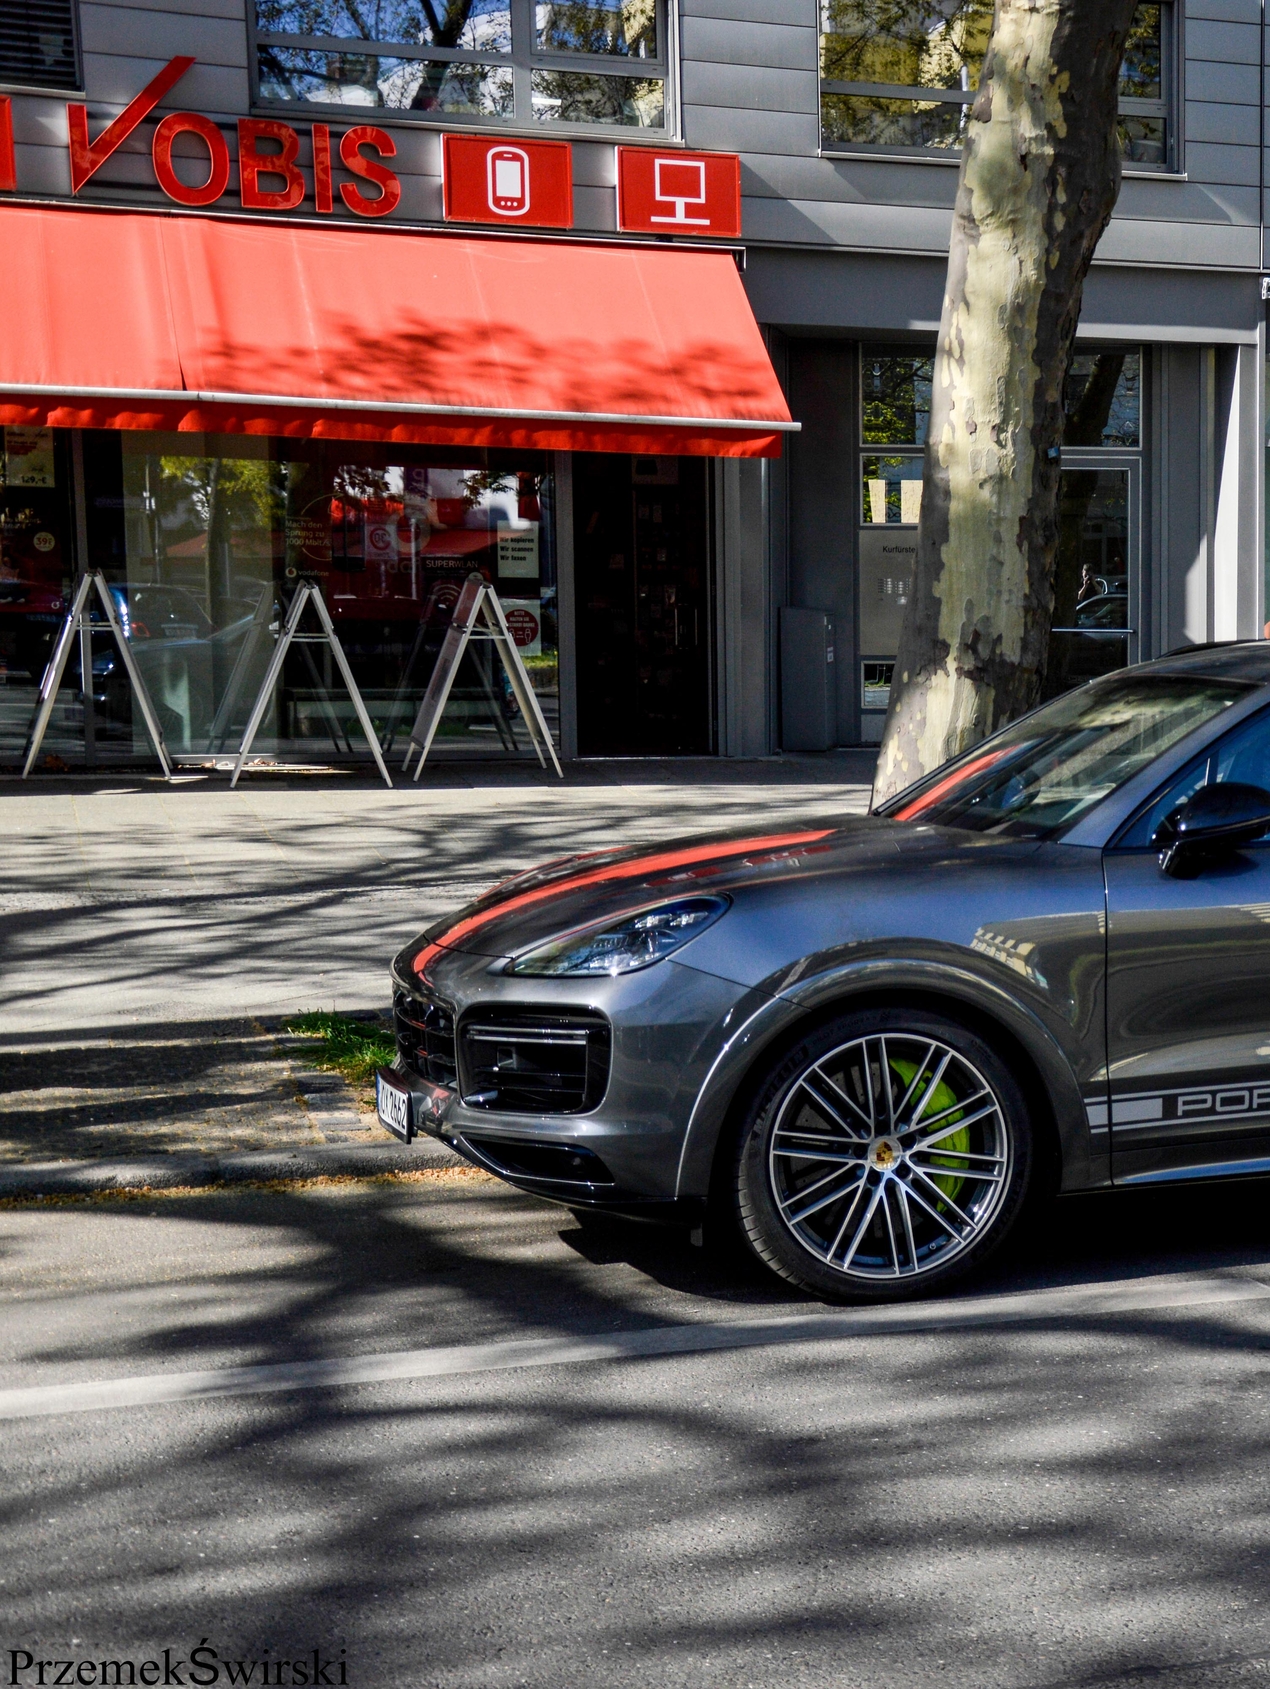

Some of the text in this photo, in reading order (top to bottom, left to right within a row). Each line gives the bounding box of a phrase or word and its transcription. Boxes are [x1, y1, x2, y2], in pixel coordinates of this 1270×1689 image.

[67, 56, 401, 217] VOBIS
[285, 520, 323, 529] Mach den
[285, 528, 313, 538] Sprung
[286, 537, 304, 546] 1000
[510, 537, 535, 546] kopieren
[426, 560, 479, 569] SUPERWLAN
[298, 569, 330, 577] vodafone
